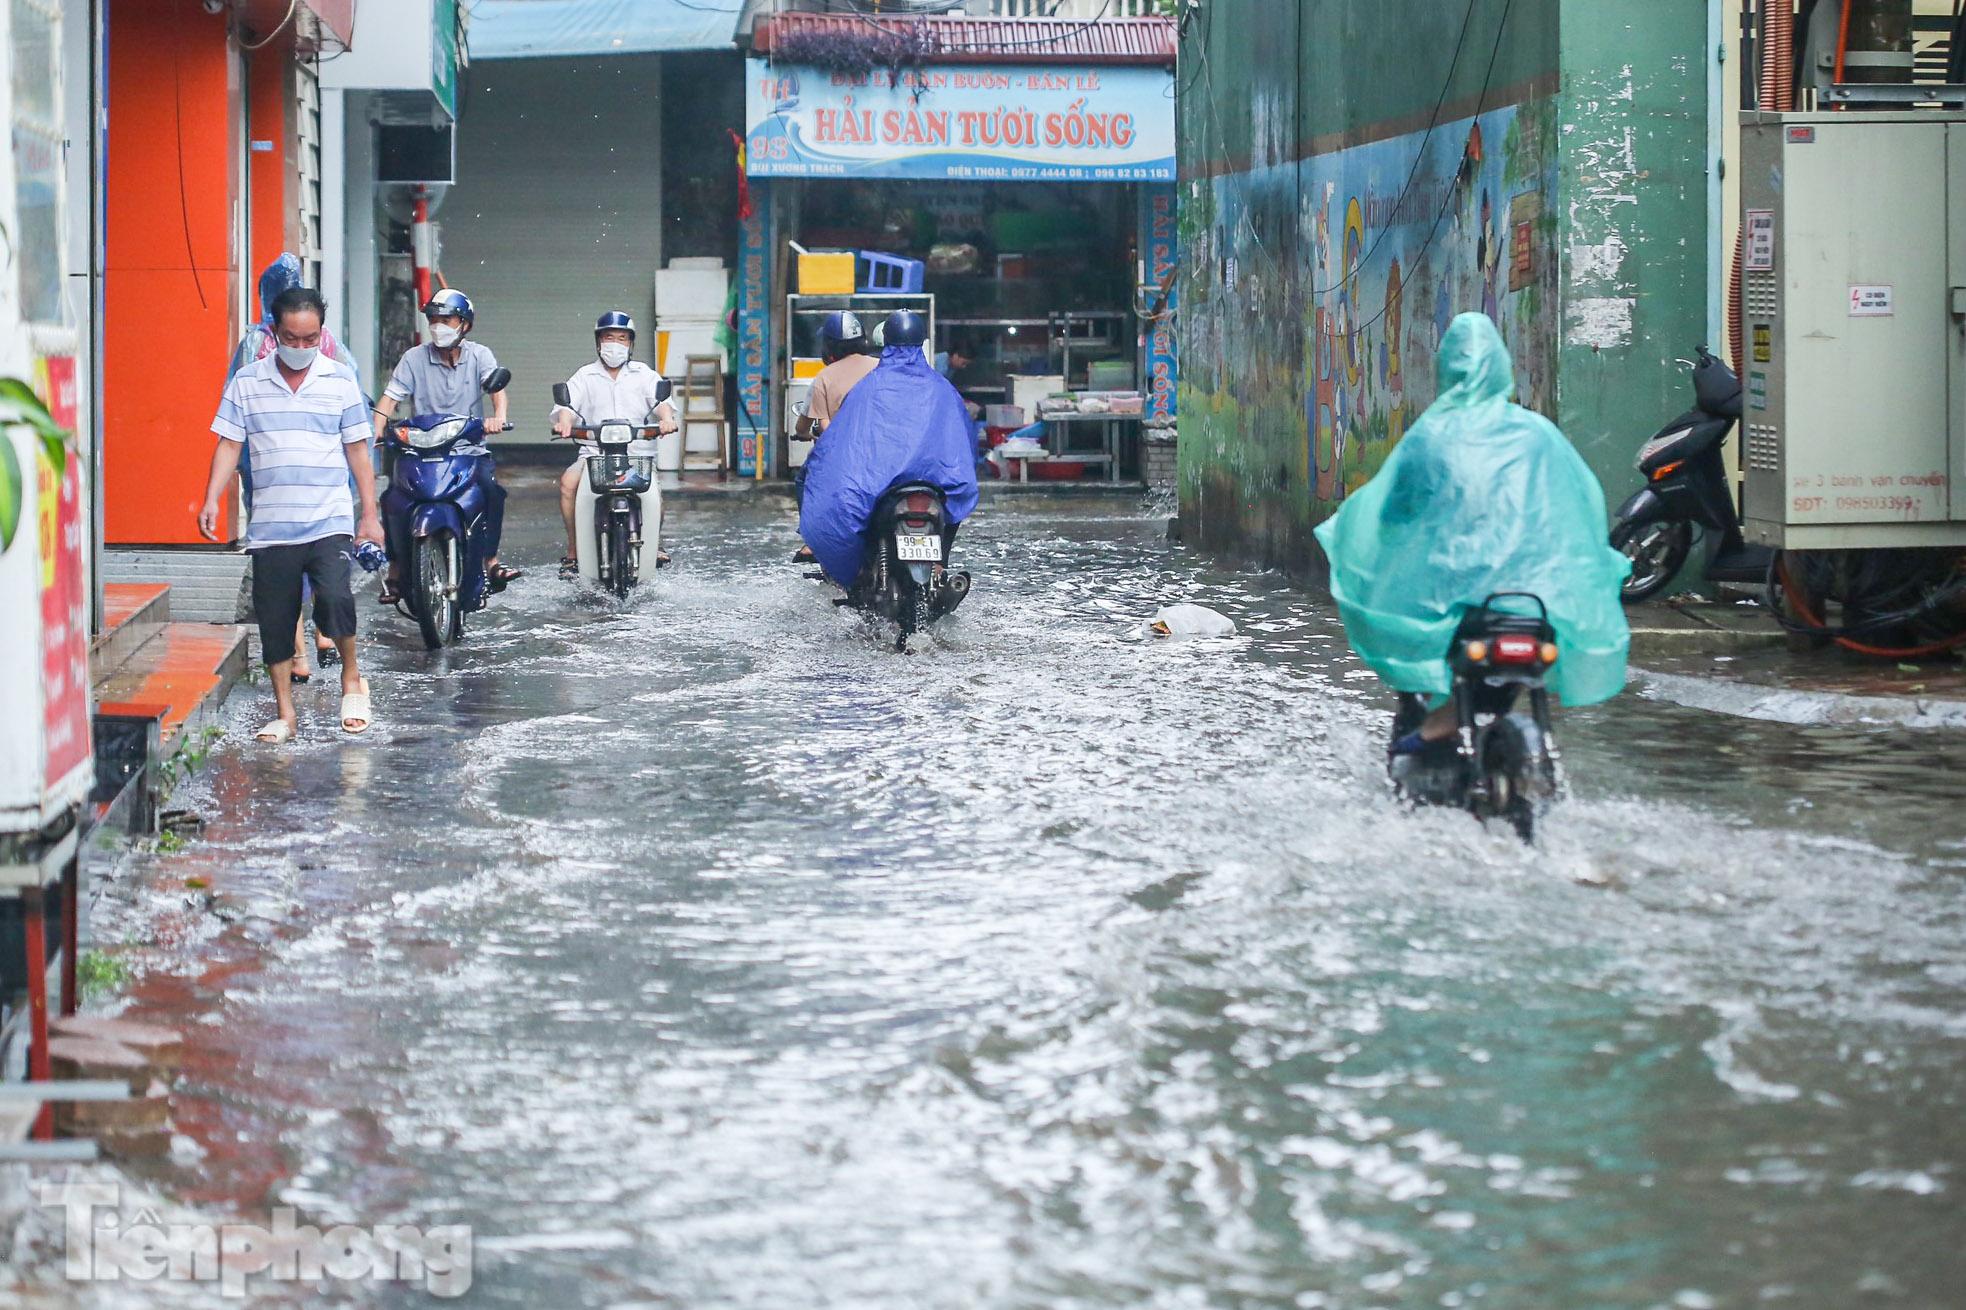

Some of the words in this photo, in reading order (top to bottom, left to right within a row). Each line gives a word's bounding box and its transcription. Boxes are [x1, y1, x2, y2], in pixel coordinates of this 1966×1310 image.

[954, 71, 1010, 90] BUÔN
[1027, 72, 1070, 90] BÁN
[814, 95, 873, 143] HẢI
[883, 96, 948, 145] SẢN
[958, 104, 1036, 147] TƯƠI
[1044, 96, 1131, 147] SỐNG
[751, 135, 789, 160] 93
